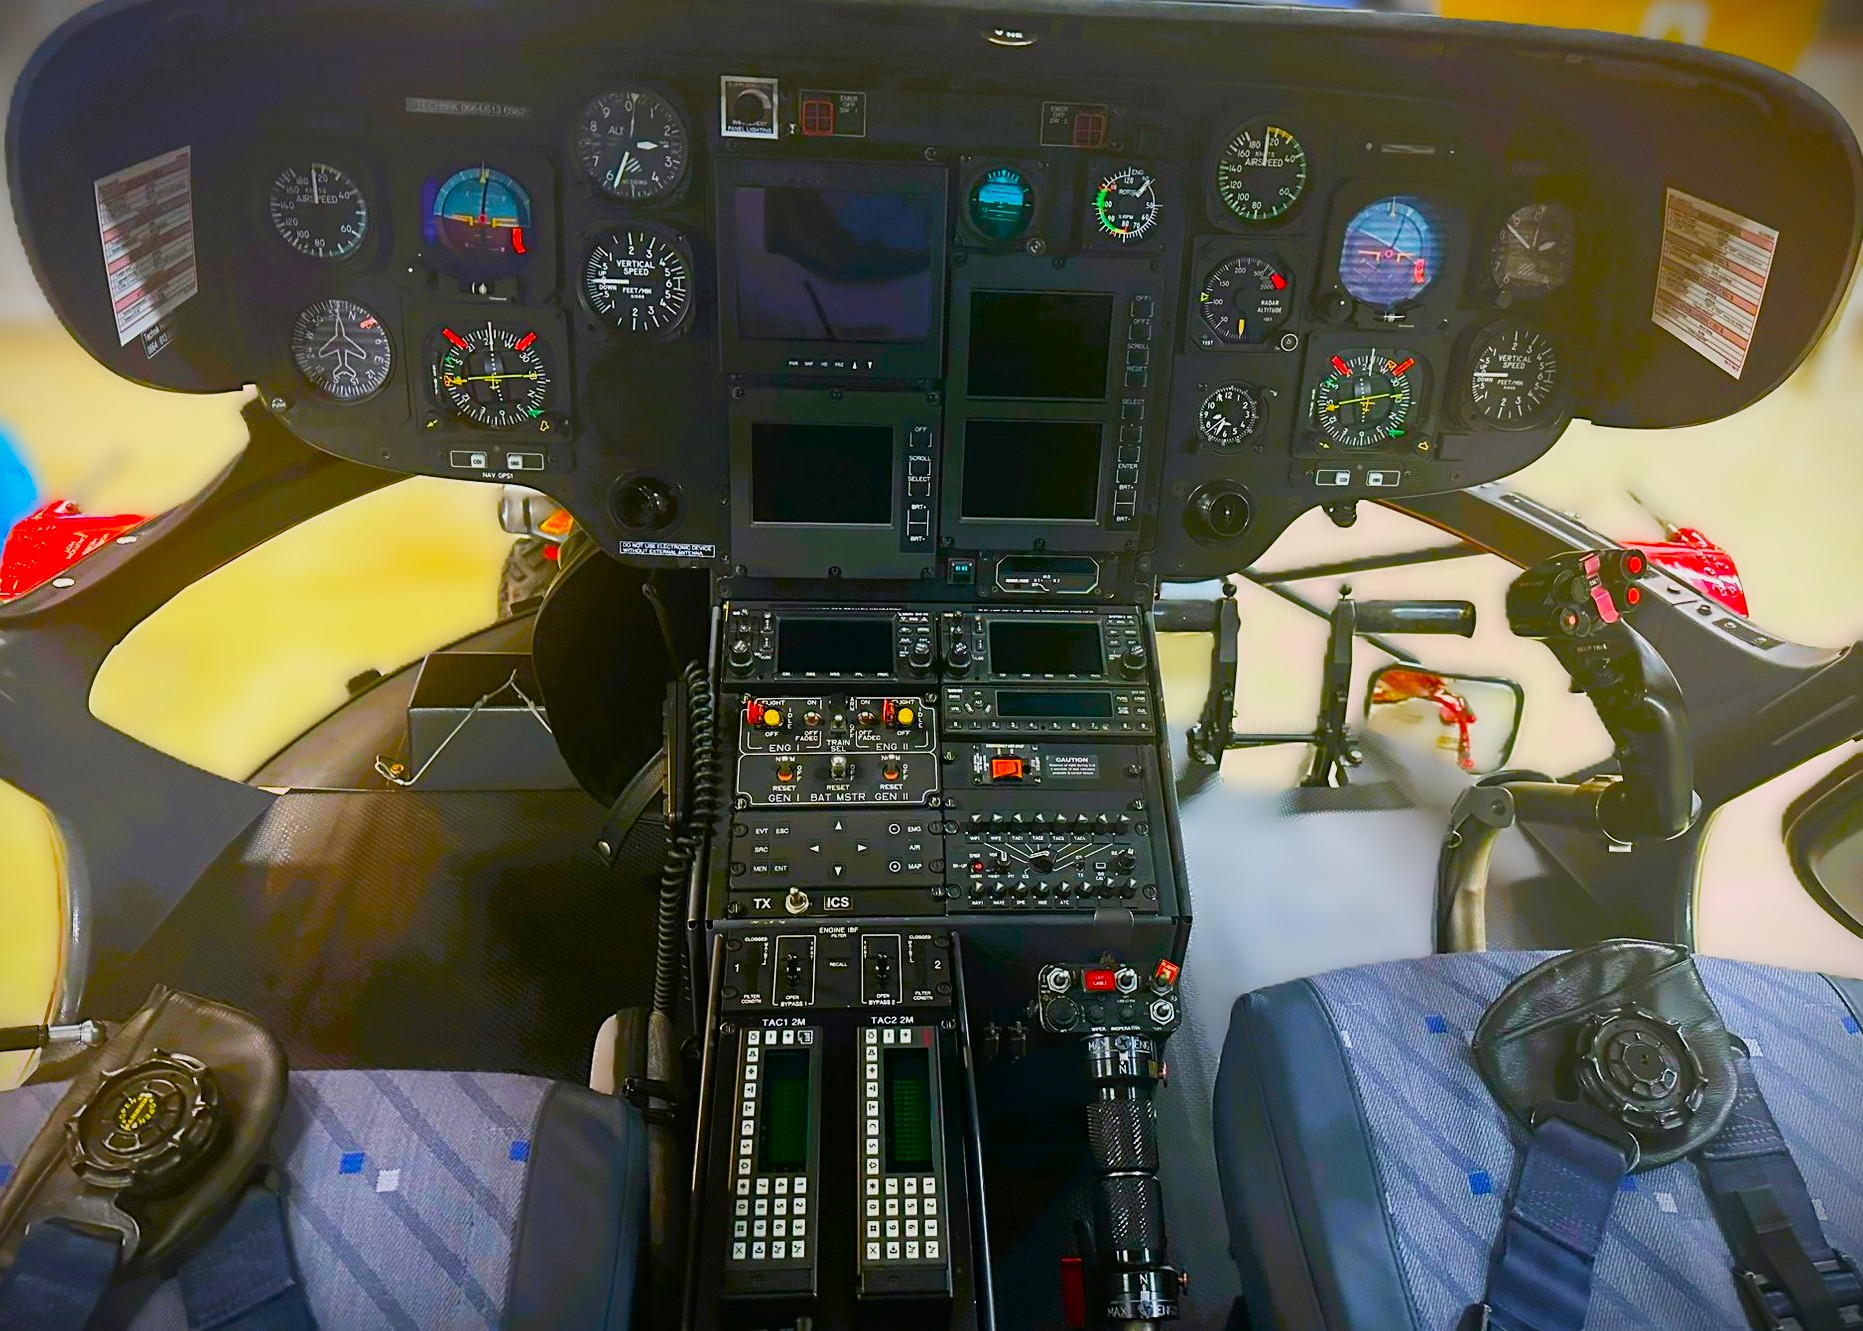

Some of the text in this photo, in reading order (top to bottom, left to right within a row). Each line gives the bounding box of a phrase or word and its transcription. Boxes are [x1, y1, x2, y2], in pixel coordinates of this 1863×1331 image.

[624, 100, 633, 112] 0
[602, 106, 611, 118] 9
[590, 120, 597, 132] 8
[608, 125, 624, 136] ALT
[664, 125, 671, 136] 2
[1249, 140, 1261, 149] 180
[1269, 138, 1279, 146] 20
[1237, 149, 1250, 158] 160
[592, 155, 600, 167] 7
[664, 156, 672, 167] 3
[1244, 157, 1284, 167] AIRSEED
[1284, 155, 1295, 163] 40
[317, 174, 328, 182] 20
[606, 169, 614, 181] 6
[651, 171, 660, 182] 4
[296, 177, 309, 185] 180
[1230, 180, 1242, 188] 120
[338, 191, 350, 200] 40
[1278, 187, 1290, 196] 60
[296, 194, 337, 204] AIRSEED
[1237, 192, 1250, 201] 100
[1251, 201, 1262, 209] 80
[1141, 213, 1149, 221] 60
[285, 218, 298, 226] 120
[1121, 219, 1130, 227] 80
[1133, 221, 1141, 229] 70
[340, 224, 352, 232] 60
[297, 230, 309, 238] 100
[314, 238, 325, 247] 80
[628, 245, 635, 255] 2
[646, 249, 653, 259] 3
[616, 259, 656, 269] VERTICAL
[623, 267, 649, 276] SPEED
[632, 307, 638, 317] 2
[647, 305, 654, 315] 3
[1257, 306, 1283, 314] ALTITUDE
[348, 311, 356, 320] N
[1511, 341, 1518, 351] 2
[1526, 344, 1533, 353] 3
[1498, 354, 1532, 363] VERTICAL
[1502, 361, 1526, 369] SPEED
[1224, 391, 1233, 399] 12
[1500, 397, 1507, 407] 2
[1515, 395, 1521, 405] 3
[1207, 401, 1215, 410] 10
[1242, 401, 1249, 409] 2
[1203, 411, 1209, 419] 9
[1245, 410, 1250, 419] 3
[1205, 420, 1211, 429] 8
[1222, 430, 1227, 438] 6
[1232, 427, 1238, 435] 5
[482, 471, 514, 480] NAV GPS1
[657, 543, 691, 551] ELECTRONIC
[691, 544, 712, 552] DEVICE
[768, 744, 792, 752] ENG
[876, 743, 910, 751] ENG II
[880, 783, 904, 791] RESET
[768, 794, 791, 803] GEN
[810, 793, 866, 802] BAT MSTR
[874, 792, 909, 801] GEN II
[755, 827, 769, 835] EVT
[775, 827, 790, 835] ESC
[907, 825, 921, 833] EMG
[754, 845, 769, 853] SRC
[908, 862, 922, 870] MAP
[754, 898, 772, 909] TX
[827, 896, 850, 908] ICS
[818, 926, 859, 934] ENGINE IBF
[734, 963, 740, 973] 1
[934, 959, 942, 970] 2
[761, 1017, 806, 1028] TAC1 2M
[870, 1015, 914, 1025] TAC2 2M
[1088, 1039, 1151, 1052] MAX ENG
[1118, 1064, 1128, 1075] N
[1139, 1273, 1149, 1285] N
[1107, 1305, 1128, 1318] MAX
